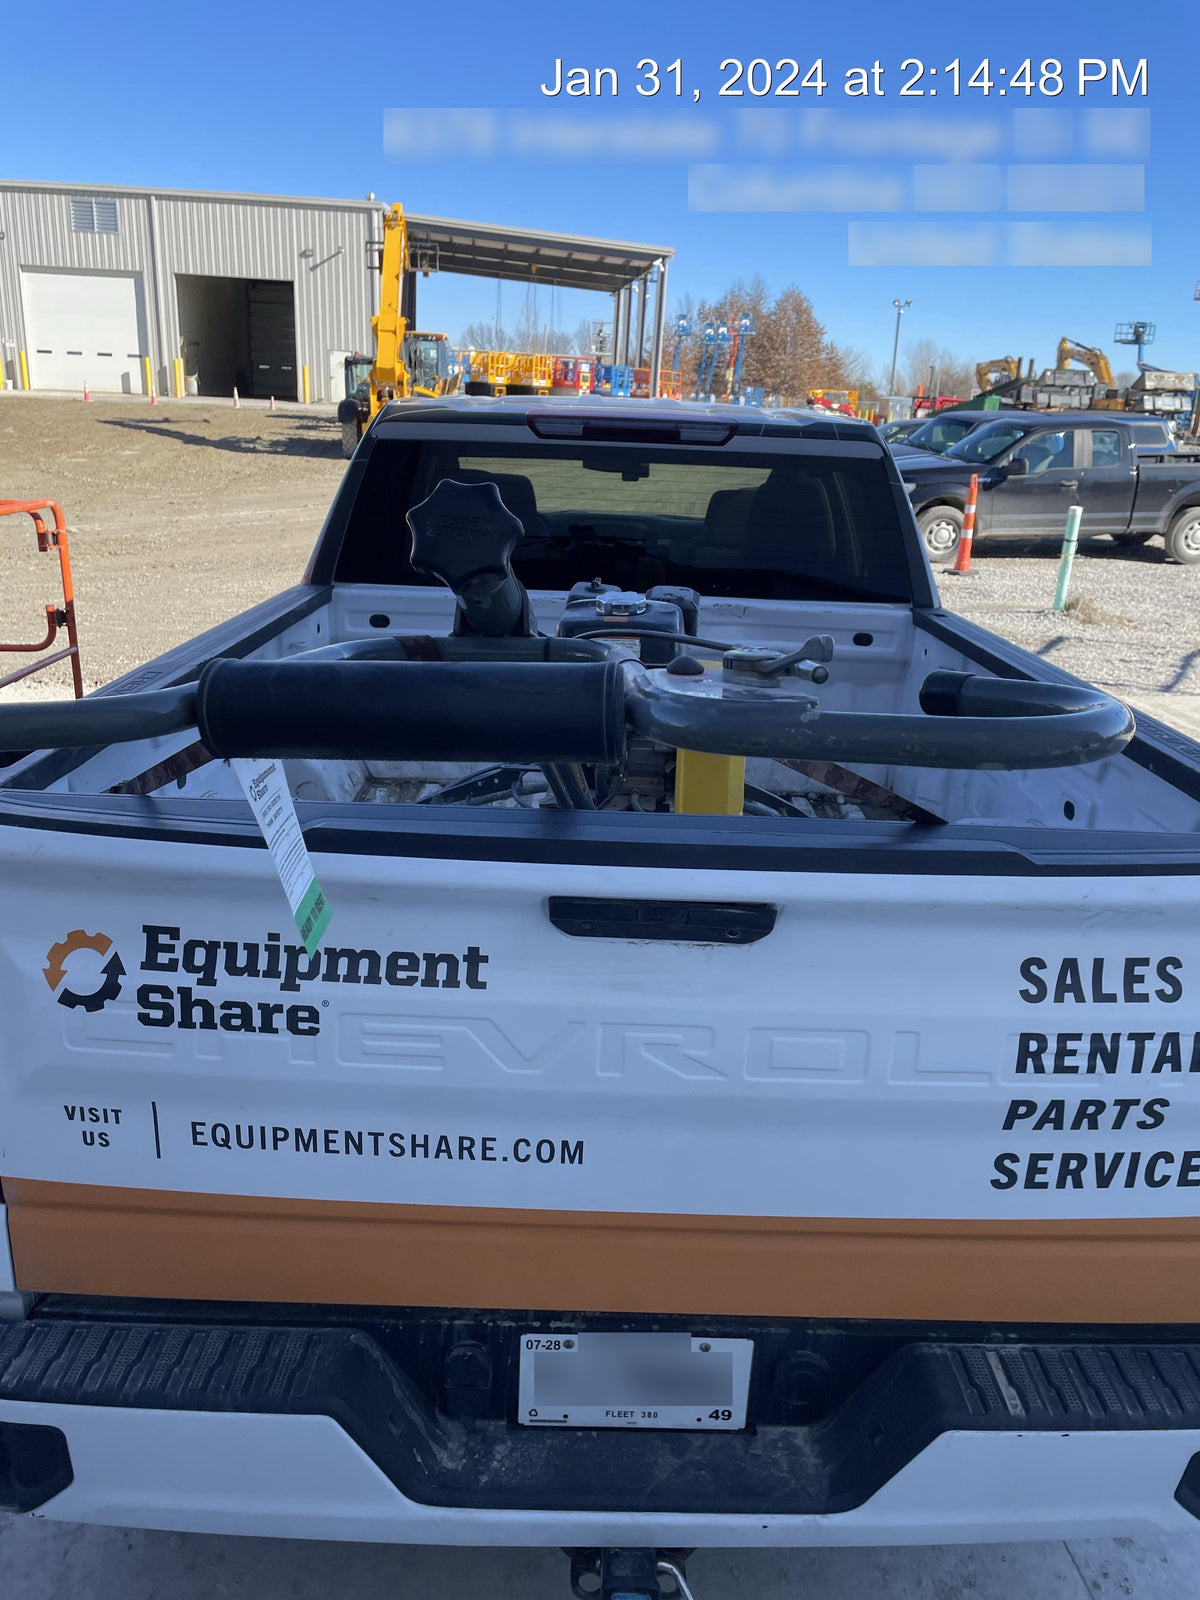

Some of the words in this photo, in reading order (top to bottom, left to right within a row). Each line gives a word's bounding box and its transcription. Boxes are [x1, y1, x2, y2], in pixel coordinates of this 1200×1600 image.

[140, 923, 490, 993] Equipment
[1018, 955, 1184, 1005] SALES
[63, 1104, 123, 1126] VISIT
[1001, 1097, 1171, 1132] PARTS
[81, 1130, 111, 1149] US
[190, 1121, 586, 1165] EQUIPMENTSHARE.COM
[525, 1339, 561, 1351] 07-28
[604, 1410, 636, 1419] FLEET
[640, 1411, 659, 1420] 380
[708, 1409, 732, 1421] 49
